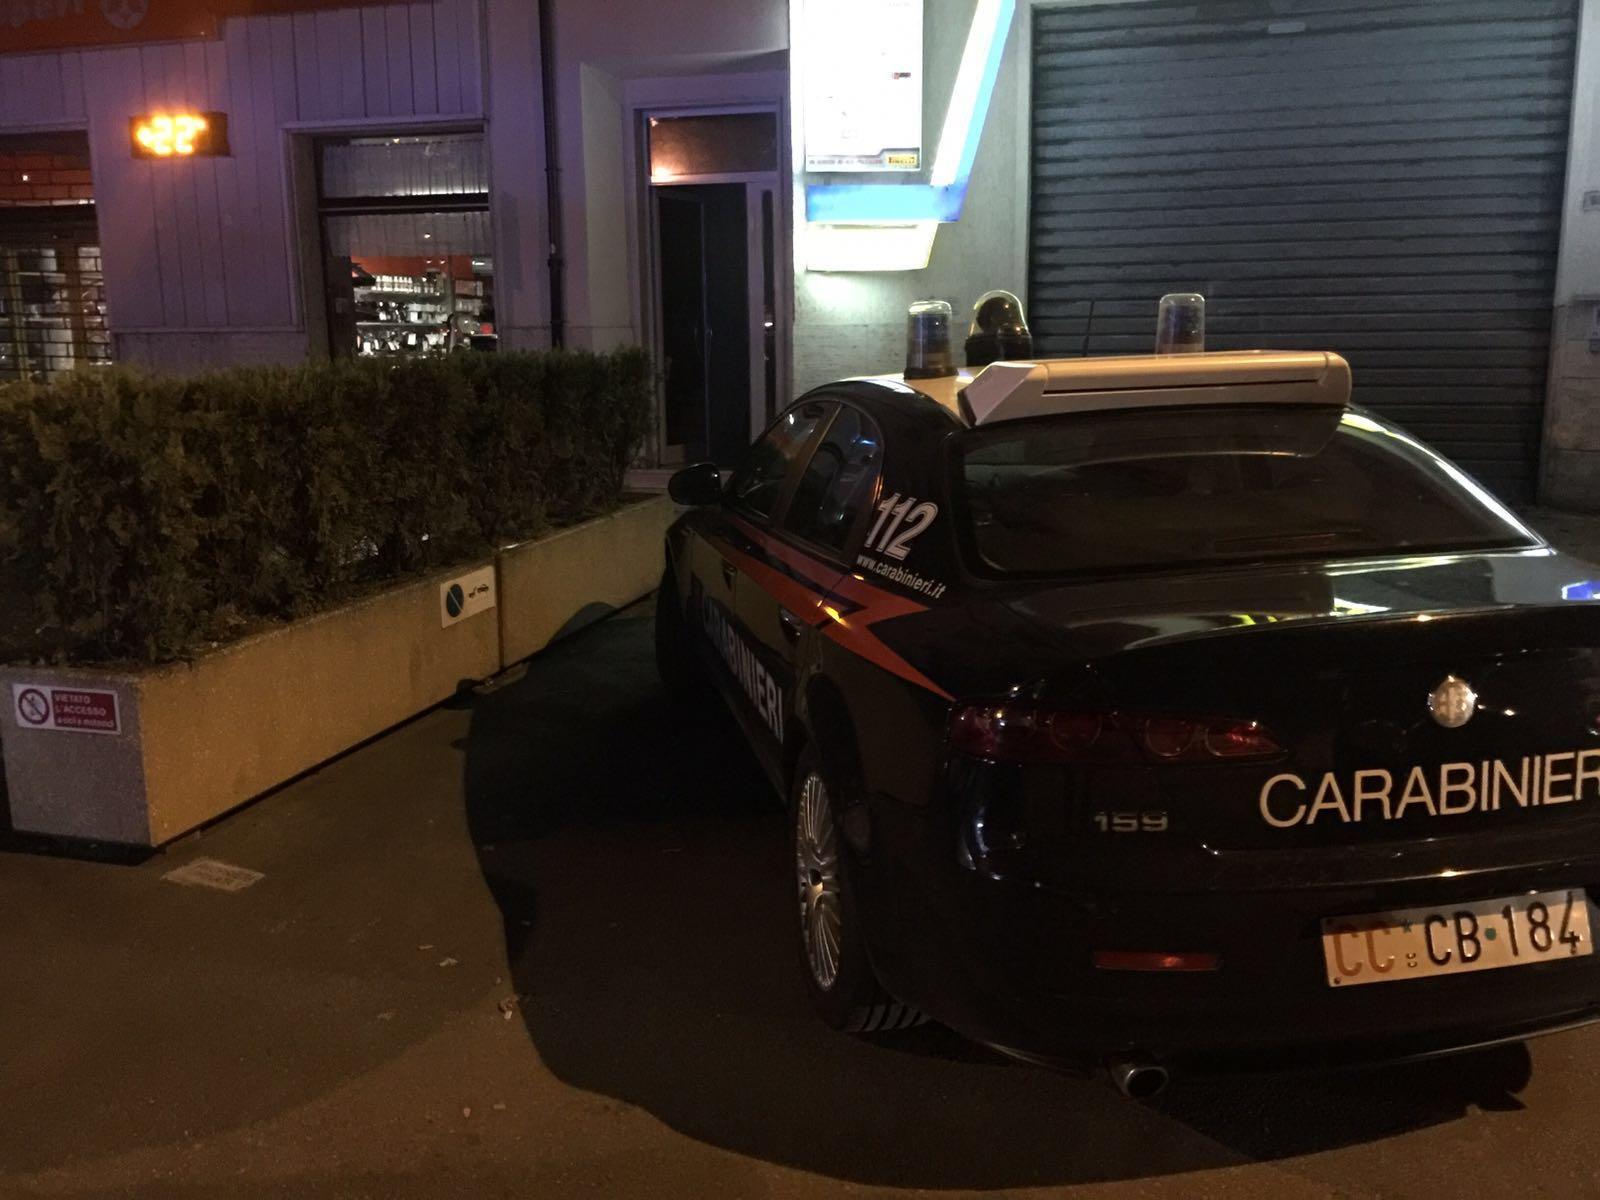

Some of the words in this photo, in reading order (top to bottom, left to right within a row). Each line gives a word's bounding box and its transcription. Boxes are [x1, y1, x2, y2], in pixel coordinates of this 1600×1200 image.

[864, 493, 939, 561] 112
[856, 555, 946, 599] www.carabinieri.it
[55, 694, 91, 705] VIETATO
[1094, 811, 1168, 832] 159
[1333, 921, 1394, 977] CC
[1425, 911, 1481, 966] CB
[1503, 891, 1581, 957] 184
